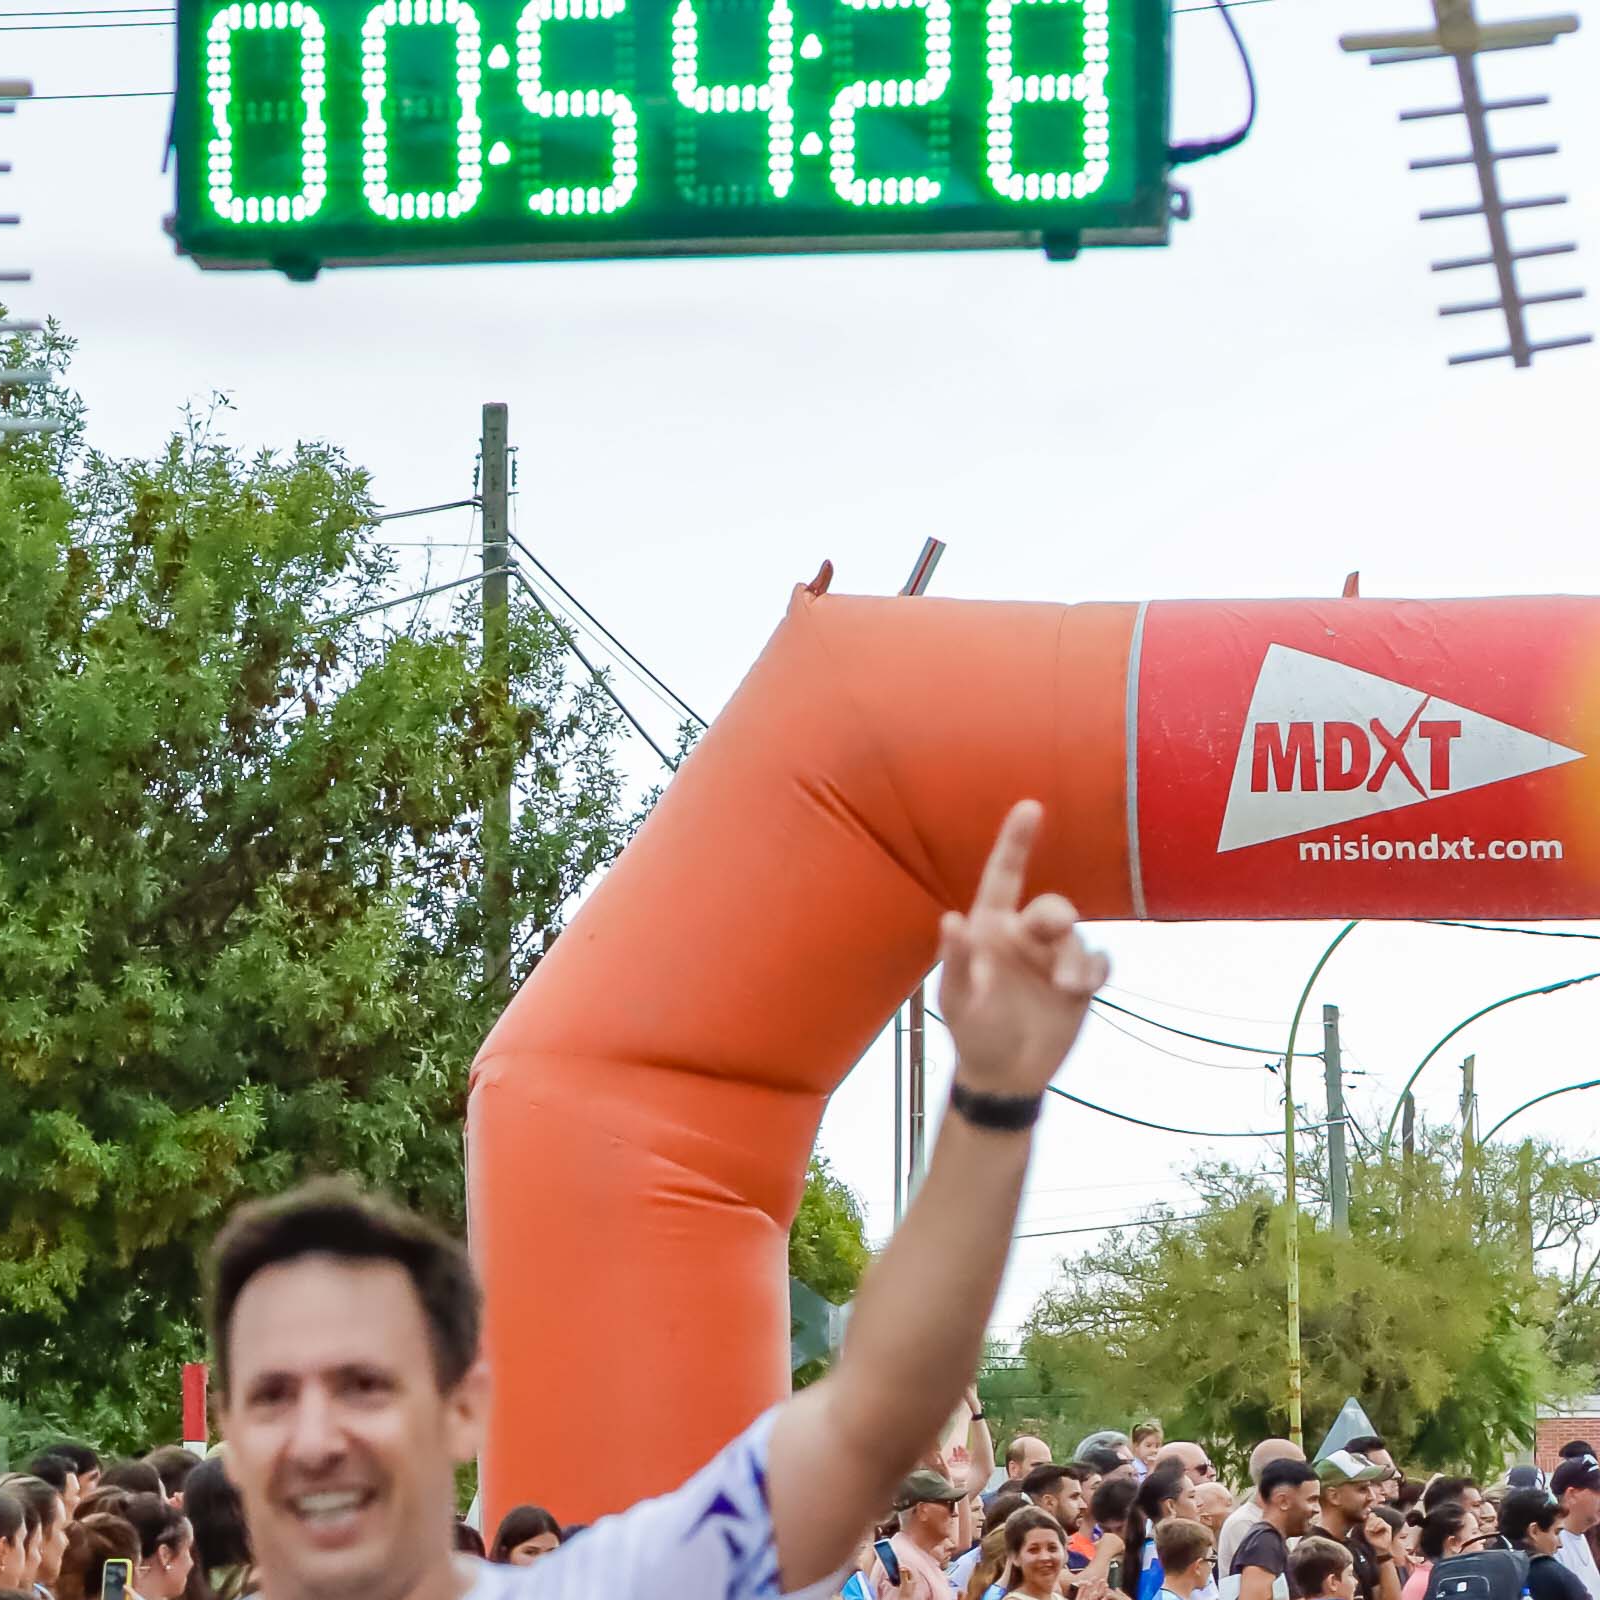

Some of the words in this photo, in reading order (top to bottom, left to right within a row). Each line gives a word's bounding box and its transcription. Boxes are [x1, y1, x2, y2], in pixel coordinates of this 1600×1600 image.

[206, 0, 1110, 223] 00:54:28
[1250, 697, 1462, 799] MDXT
[1298, 833, 1564, 861] misiondxt.com
